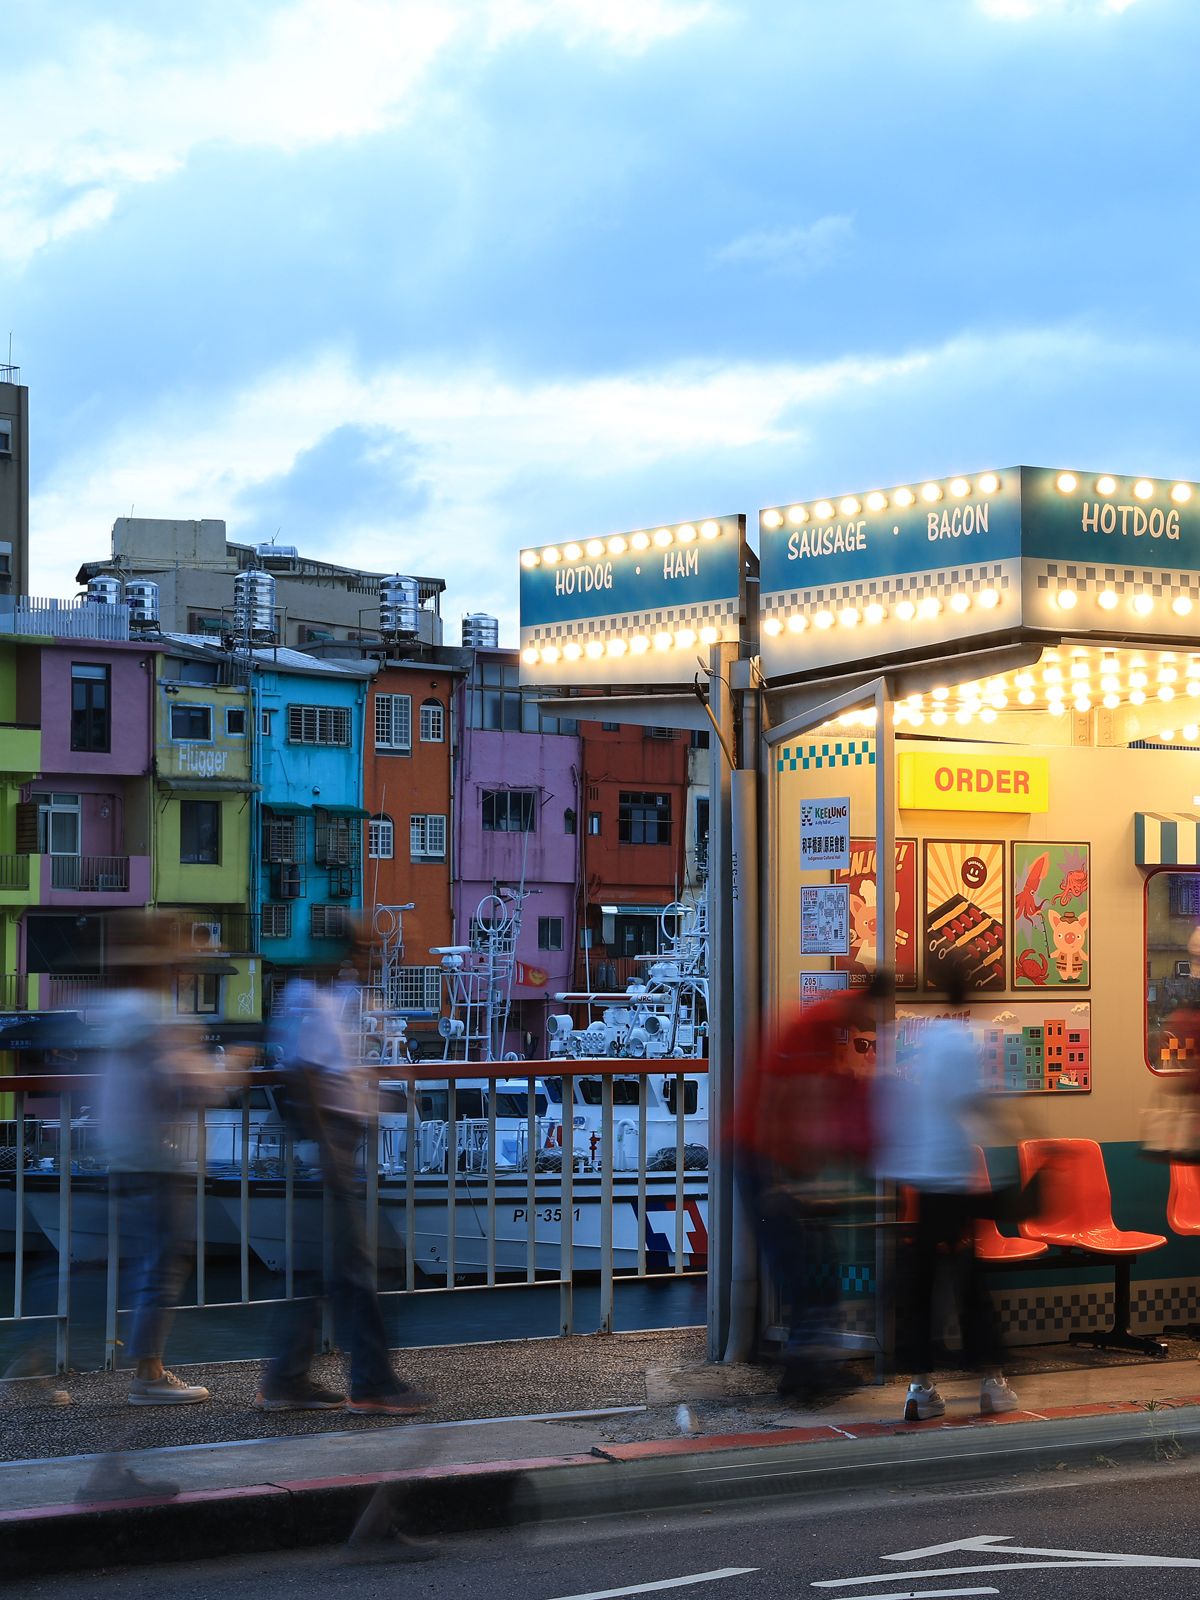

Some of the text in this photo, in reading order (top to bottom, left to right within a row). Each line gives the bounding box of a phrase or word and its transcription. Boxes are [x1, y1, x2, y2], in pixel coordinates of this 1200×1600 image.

[787, 502, 989, 561] SAUSAGE BACON
[1081, 501, 1181, 541] HOTDOG
[555, 548, 699, 597] HOTDOG HAM
[179, 744, 228, 777] Flügger
[934, 766, 1030, 795] ORDER
[815, 806, 847, 819] KEELUNG
[804, 977, 817, 986] 205
[513, 1208, 581, 1223] P-351
